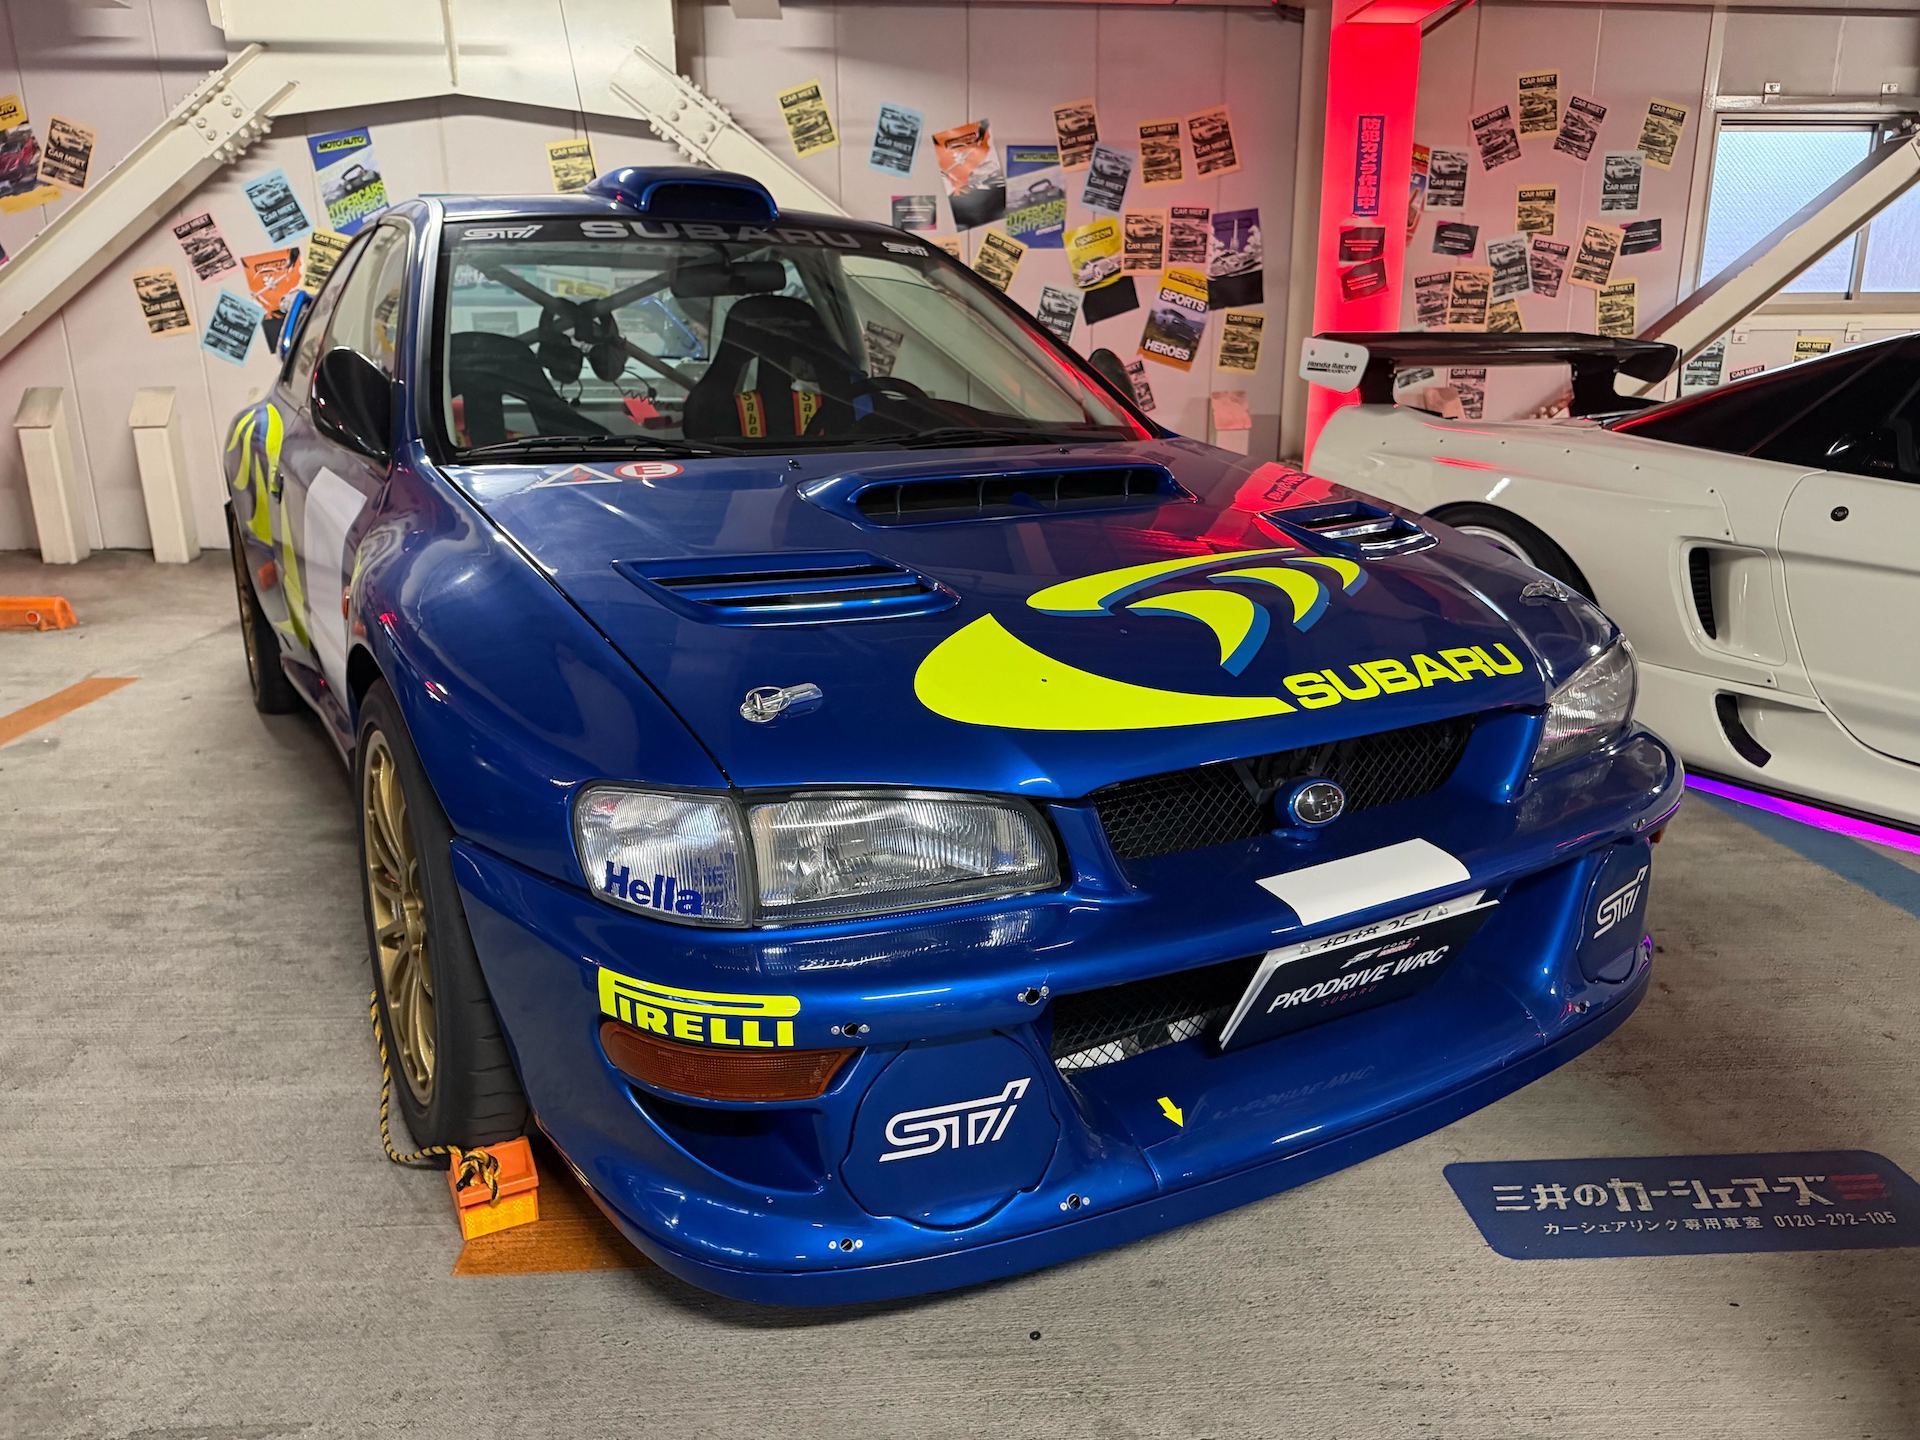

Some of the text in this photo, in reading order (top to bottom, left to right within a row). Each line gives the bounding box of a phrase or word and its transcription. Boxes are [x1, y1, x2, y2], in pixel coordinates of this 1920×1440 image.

[1521, 76, 1555, 85] CAR MEET
[1572, 98, 1605, 114] CAR MEET
[1652, 104, 1684, 118] CAR MEET
[1474, 108, 1507, 125] CAR MEET
[1142, 124, 1178, 134] CAR MEET
[318, 136, 365, 150] MOTO AUTO
[878, 136, 912, 150] CAR MEET
[1062, 133, 1097, 146] CAR MEET
[1197, 140, 1230, 154] CAR MEET
[48, 149, 86, 168] CAR MEET
[1357, 118, 1381, 210] 防犯カメラ作動中
[1090, 176, 1124, 192] CAR MEET
[1431, 179, 1464, 187] CAR MEET
[327, 180, 385, 219] HYPERCARS
[1536, 190, 1554, 198] MEET
[263, 201, 296, 223] CAR MEET
[1173, 208, 1208, 216] CAR MEET
[175, 214, 210, 235] CAR MEET
[314, 234, 350, 248] CAR MEET
[579, 220, 861, 249] SUBARU
[989, 235, 1021, 256] CAR MEET
[1127, 242, 1160, 250] CAR MEET
[1536, 240, 1568, 252] CAR MEET
[1579, 252, 1611, 266] CAR MEET
[1508, 266, 1526, 276] MEET
[1416, 273, 1449, 284] CAR MEET
[145, 299, 181, 314] CAR MEET
[1160, 289, 1207, 312] SPORTS
[1468, 298, 1486, 306] MEET
[1039, 314, 1072, 328] CAR MEET
[1228, 314, 1262, 324] CAR MEET
[212, 322, 250, 343] CAR MEET
[1145, 338, 1190, 360] HEROES
[1812, 342, 1830, 350] MEET
[1307, 360, 1331, 369] Honda
[1689, 360, 1721, 369] CAR MEET
[1452, 368, 1485, 376] CAR MEET
[1731, 365, 1764, 379] CAR MEET
[634, 464, 667, 476] E
[1282, 643, 1524, 710] SUBARU
[604, 860, 702, 916] Hella
[1266, 945, 1450, 1014] PRODRIVE WRC
[1320, 985, 1378, 1008] SUBARU
[598, 966, 801, 1048] PIRELLI
[1492, 1176, 1835, 1212] 三井のカーシェアーズ
[1773, 1211, 1898, 1230] 0120-292-105
